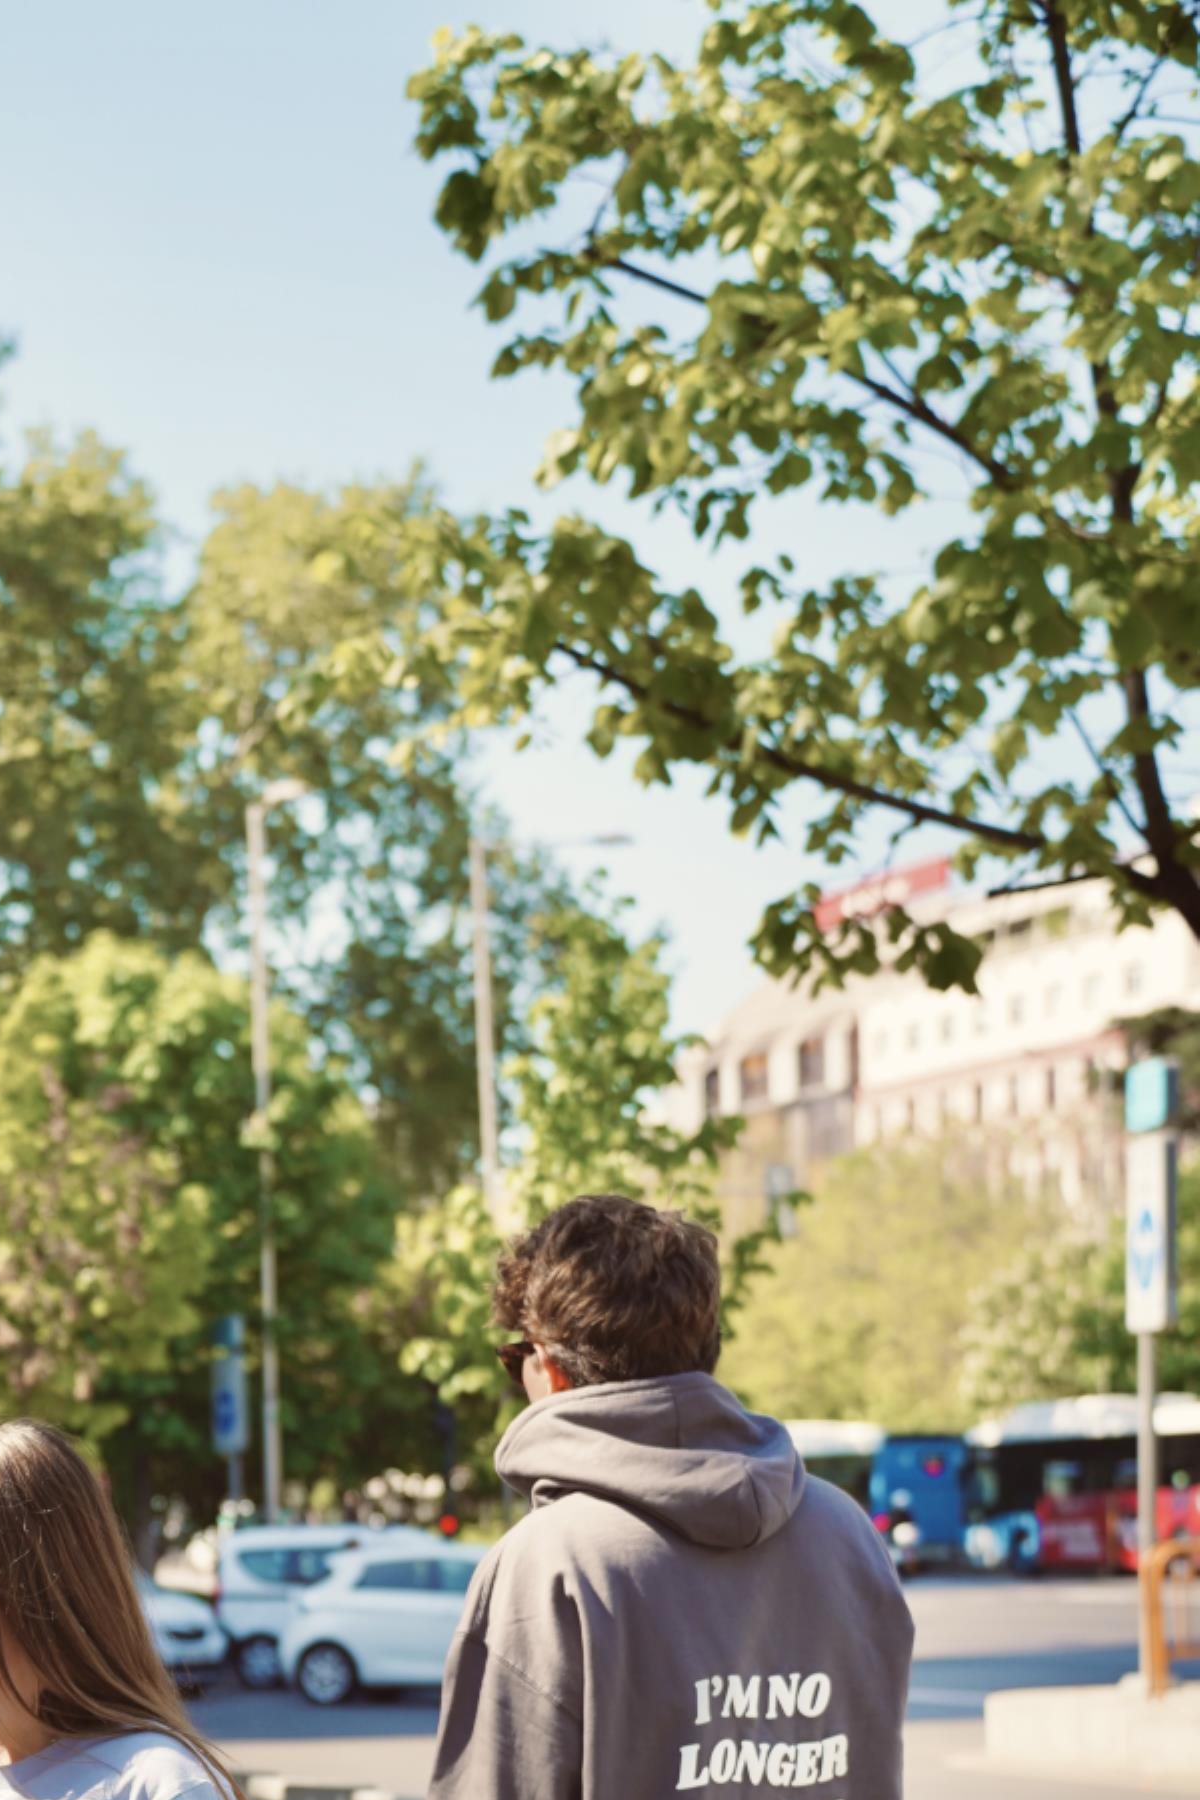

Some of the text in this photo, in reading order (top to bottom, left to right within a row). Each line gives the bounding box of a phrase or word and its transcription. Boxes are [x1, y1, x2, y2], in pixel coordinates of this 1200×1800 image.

[693, 1672, 832, 1726] I'M NO
[675, 1734, 849, 1790] LONGER
